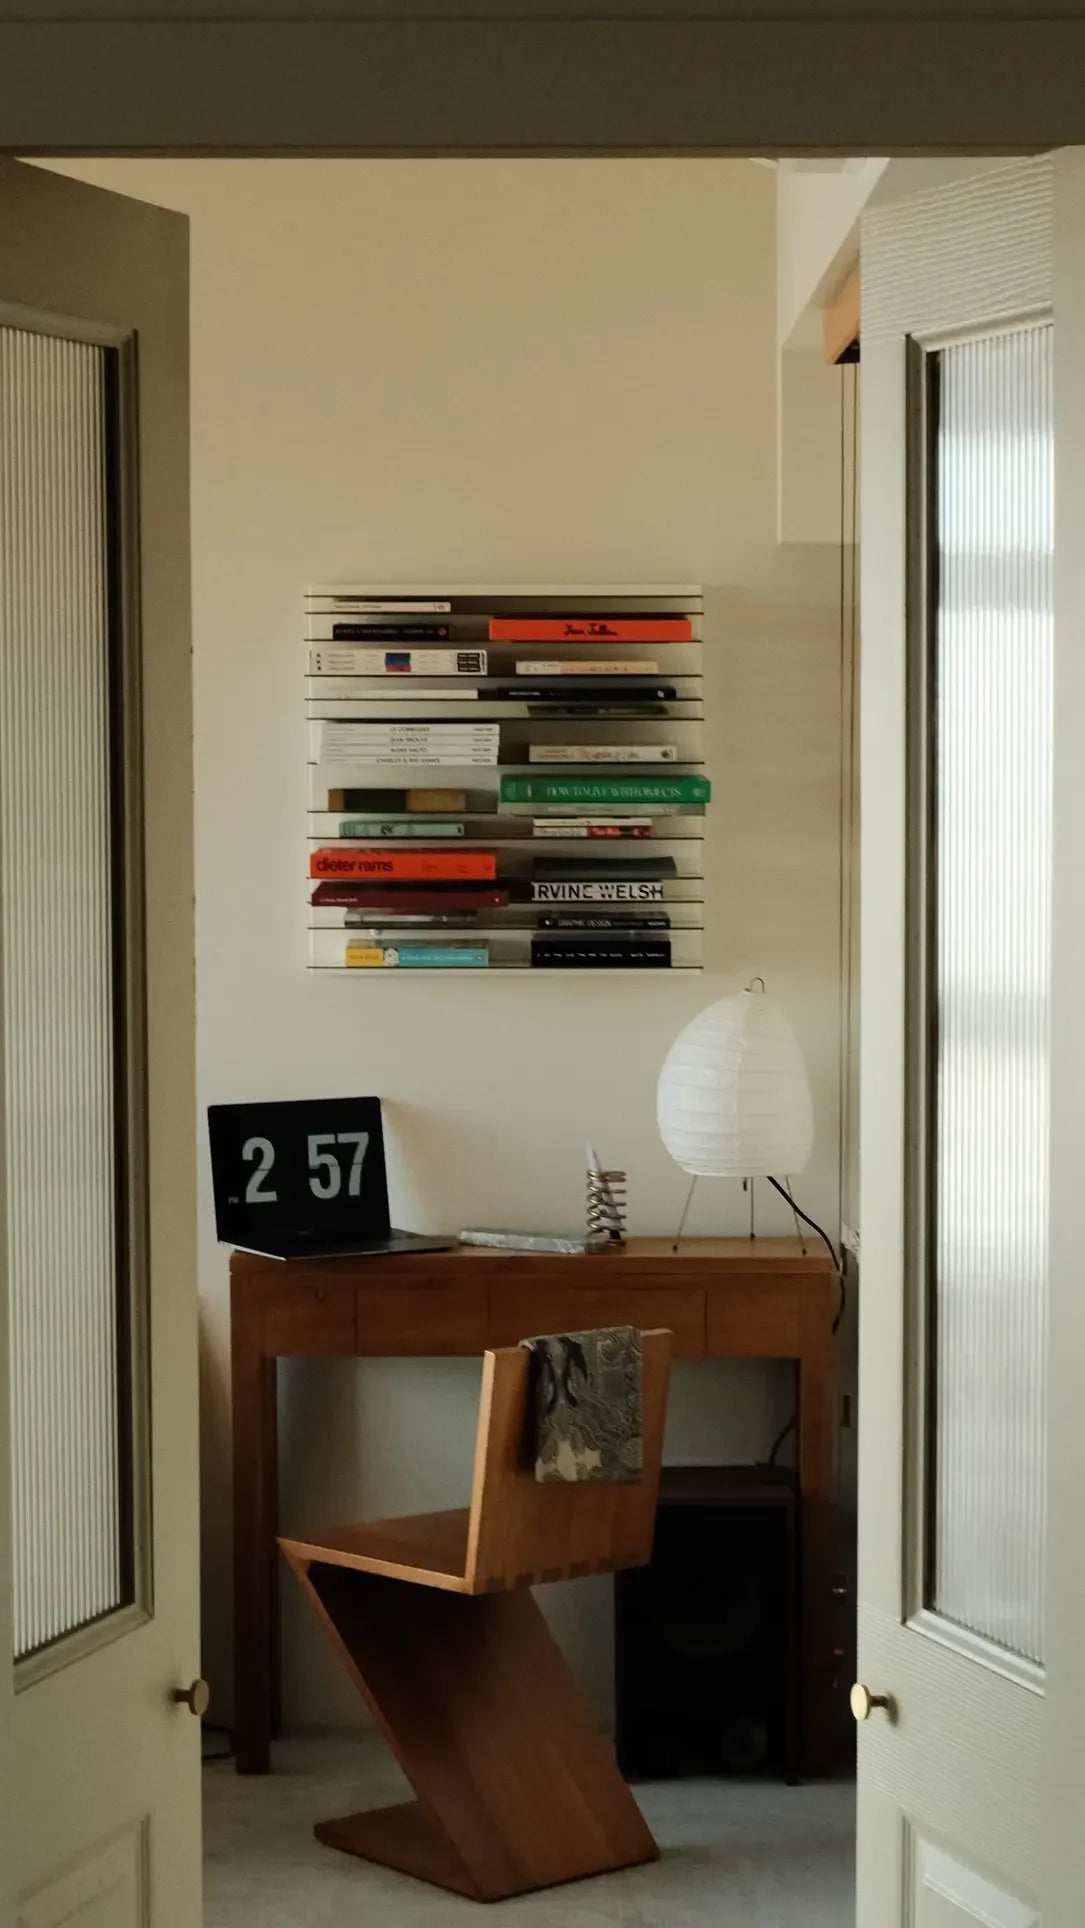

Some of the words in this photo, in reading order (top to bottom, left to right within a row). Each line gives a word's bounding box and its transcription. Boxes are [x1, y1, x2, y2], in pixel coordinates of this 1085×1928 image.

[316, 857, 356, 873] dieter
[358, 859, 394, 873] rams
[533, 884, 593, 899] IRVINE
[598, 884, 665, 899] WELSH
[242, 1137, 278, 1204] 2
[307, 1132, 370, 1200] 57
